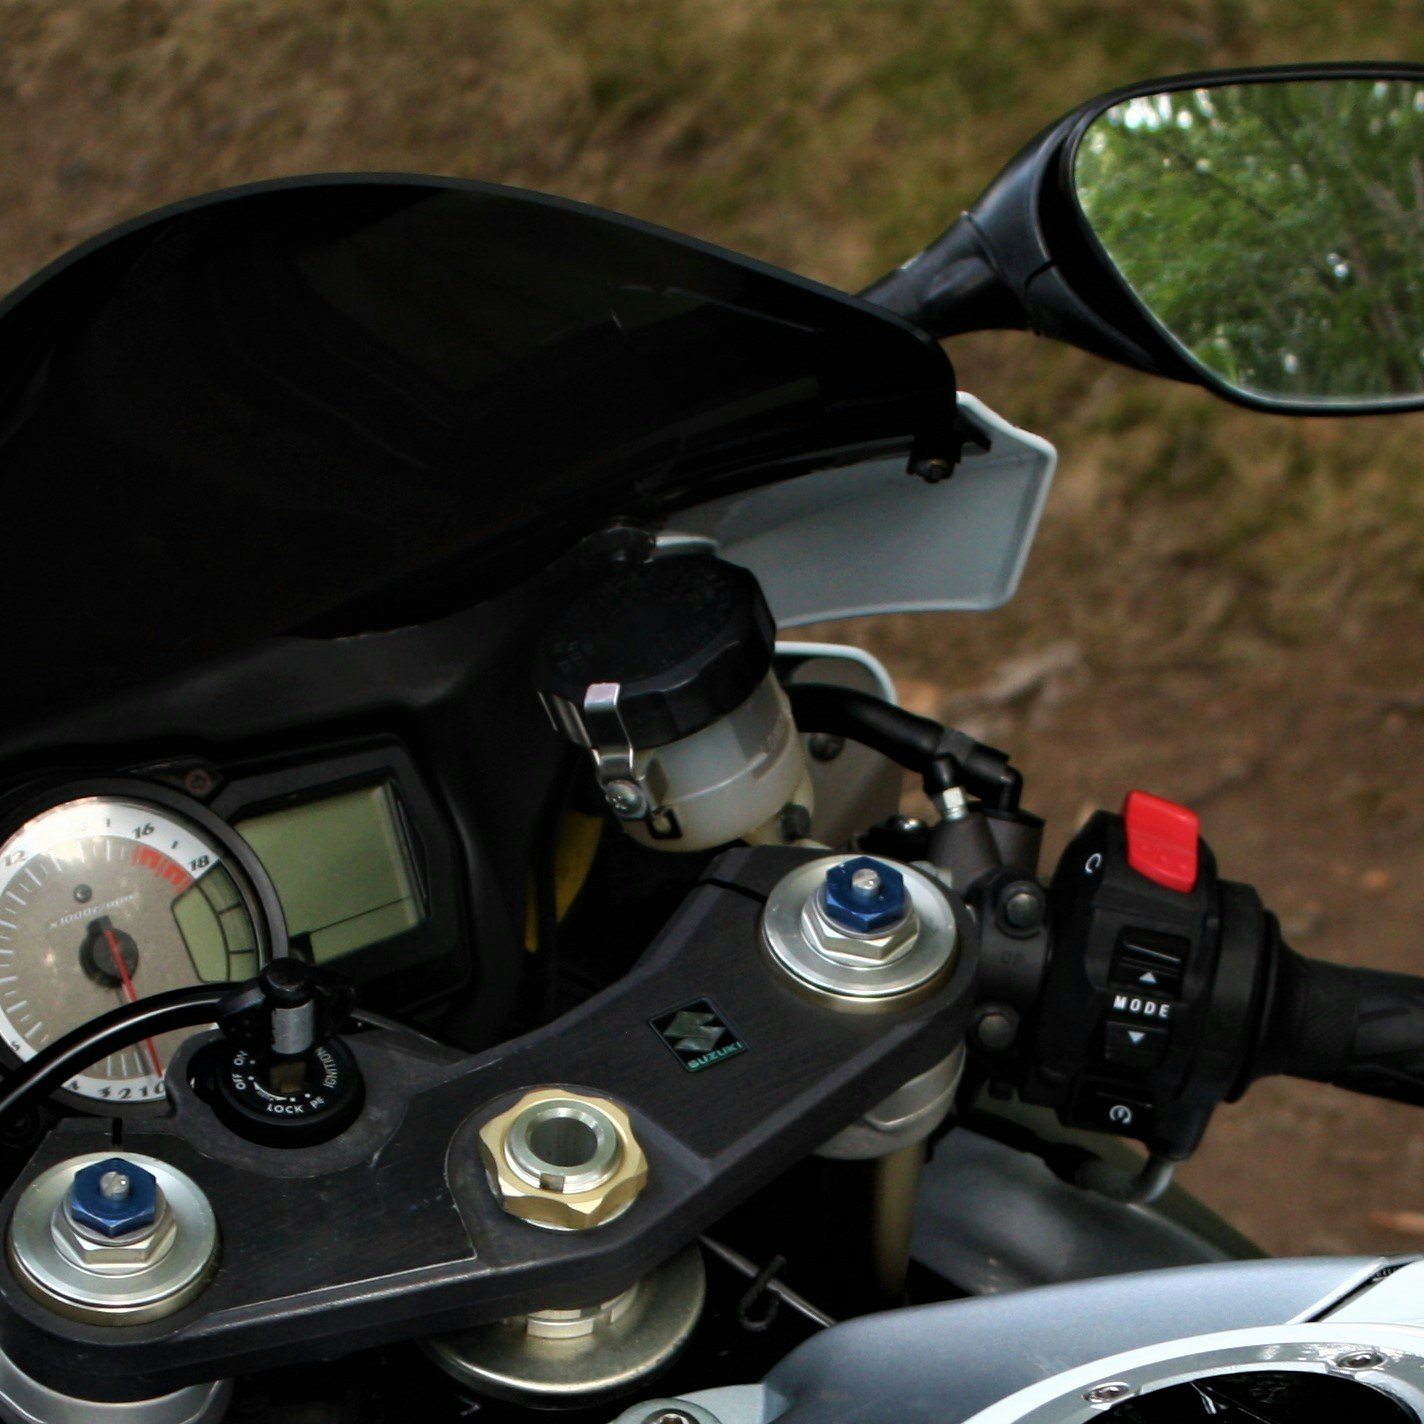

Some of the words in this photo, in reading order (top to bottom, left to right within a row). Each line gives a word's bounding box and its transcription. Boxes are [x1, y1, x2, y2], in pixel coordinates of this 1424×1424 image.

[132, 823, 155, 839] 16
[188, 855, 210, 871] 18
[1113, 995, 1170, 1018] MODE
[233, 1050, 249, 1066] ON
[687, 1041, 743, 1069] SUZUKI
[314, 1047, 338, 1088] IGNITION
[231, 1073, 246, 1090] OFF
[118, 1088, 131, 1099] 2
[140, 1086, 147, 1097] 1
[267, 1103, 304, 1114] LOCK
